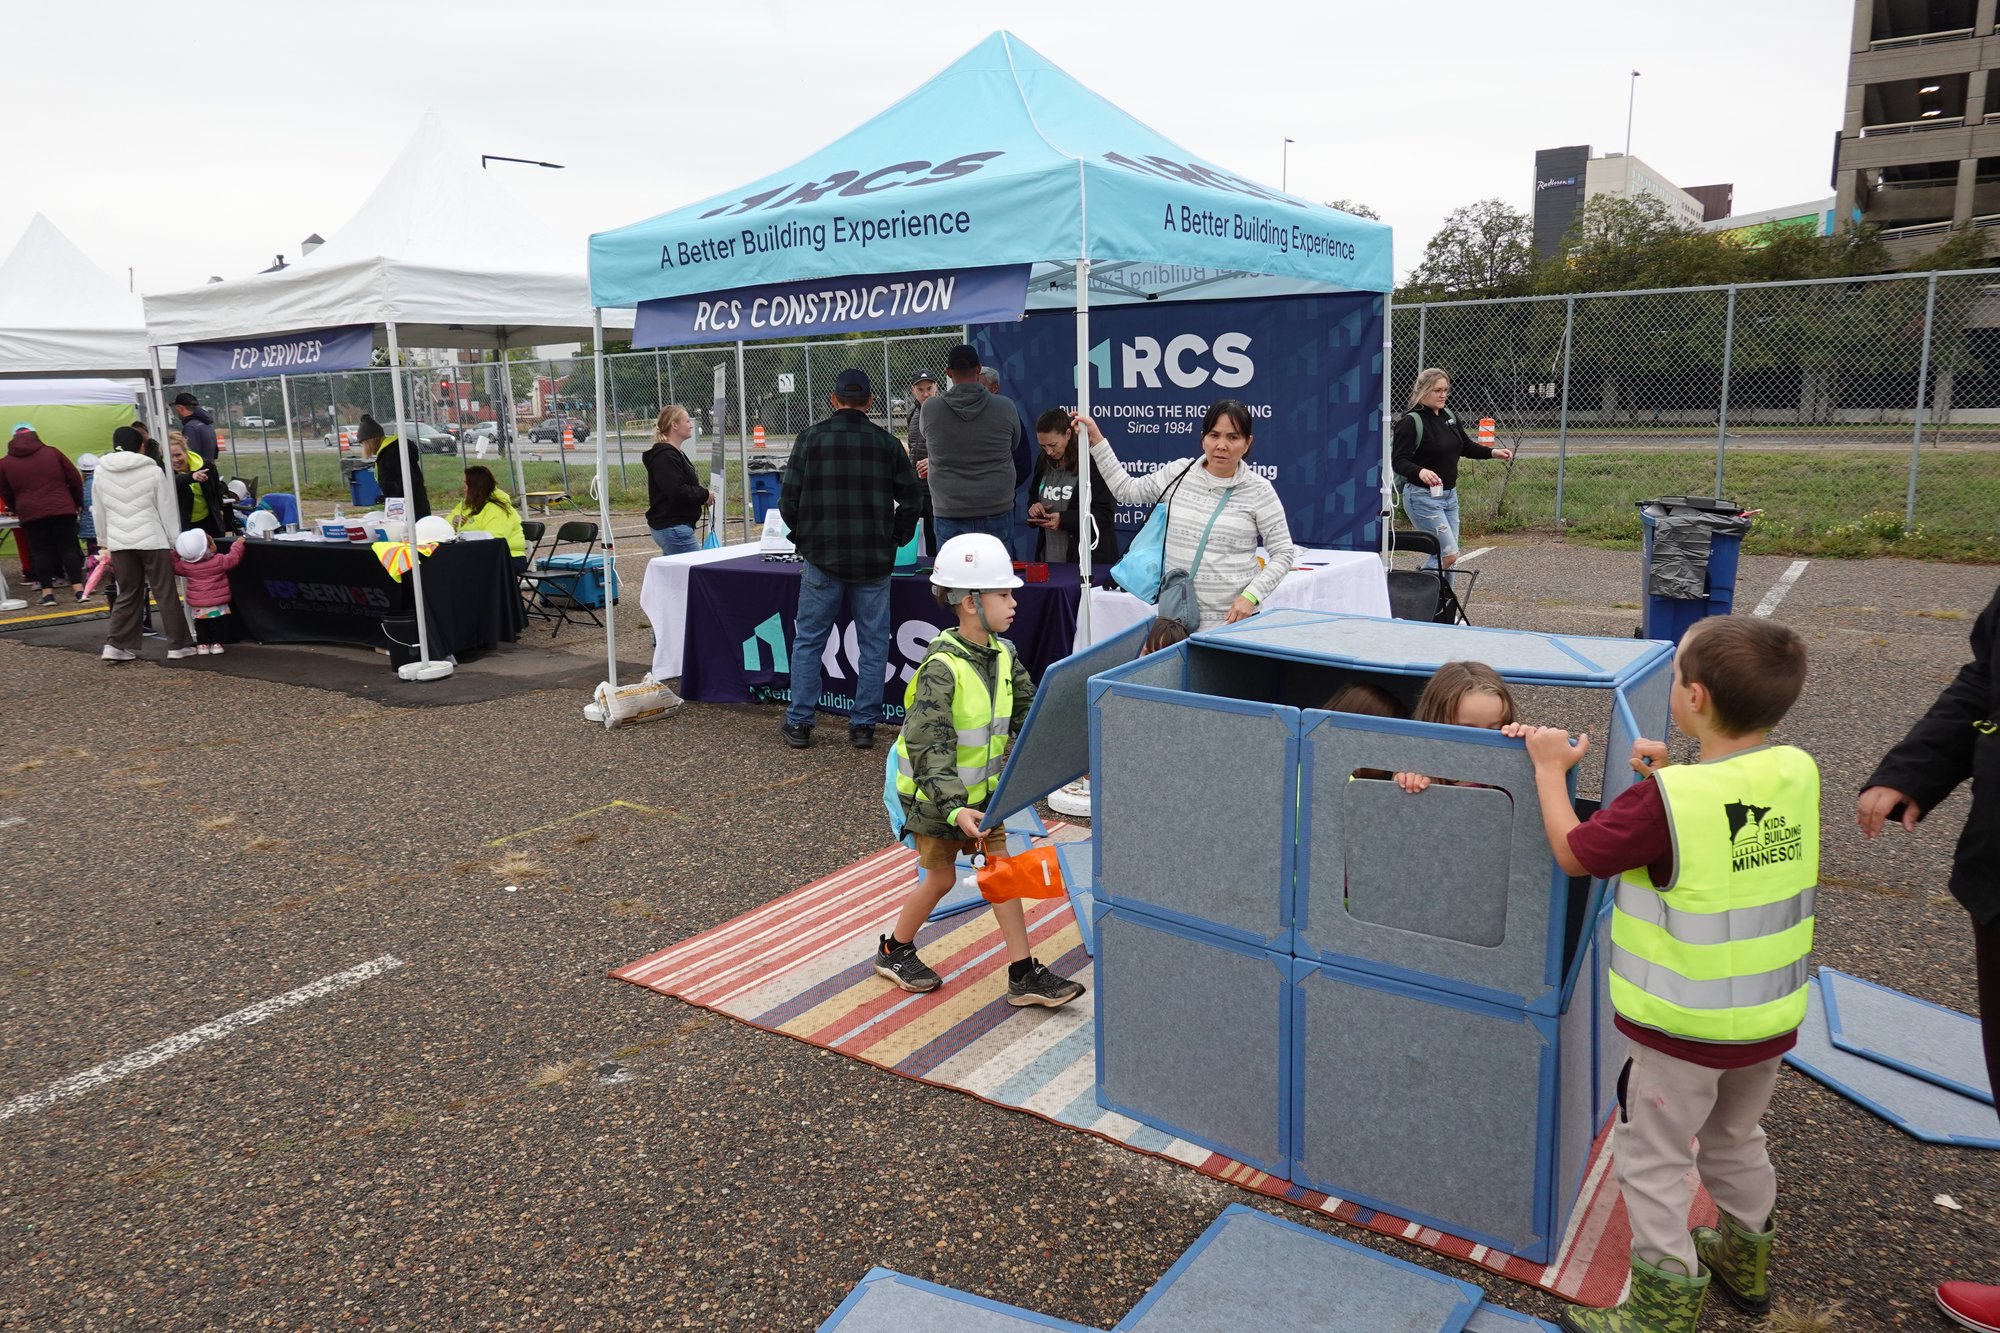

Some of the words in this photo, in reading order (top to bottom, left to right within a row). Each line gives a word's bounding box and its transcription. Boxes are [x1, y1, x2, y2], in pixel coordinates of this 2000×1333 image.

[761, 151, 1006, 211] RCS
[660, 245, 675, 269] A
[678, 234, 736, 266] Better
[741, 220, 826, 255] Building
[833, 209, 971, 248] Experience
[1164, 203, 1176, 231] A
[1181, 205, 1230, 238] Better
[1234, 213, 1288, 253] Building
[1292, 225, 1355, 261] Experience
[694, 300, 742, 331] RCS
[750, 276, 955, 328] CONSTRUCTION
[231, 347, 260, 370] FCP
[261, 340, 323, 368] SERVICES
[1121, 332, 1255, 389] RCS
[1093, 405, 1112, 418] ON
[1114, 405, 1155, 418] DOING
[1159, 405, 1183, 418] THE
[1185, 405, 1211, 418] RIG
[1127, 421, 1160, 434] Since
[1164, 422, 1193, 434] 1984
[1043, 485, 1073, 501] RCS
[297, 582, 391, 608] SERVICES
[818, 691, 855, 710] uildin
[1764, 816, 1786, 831] KIDS
